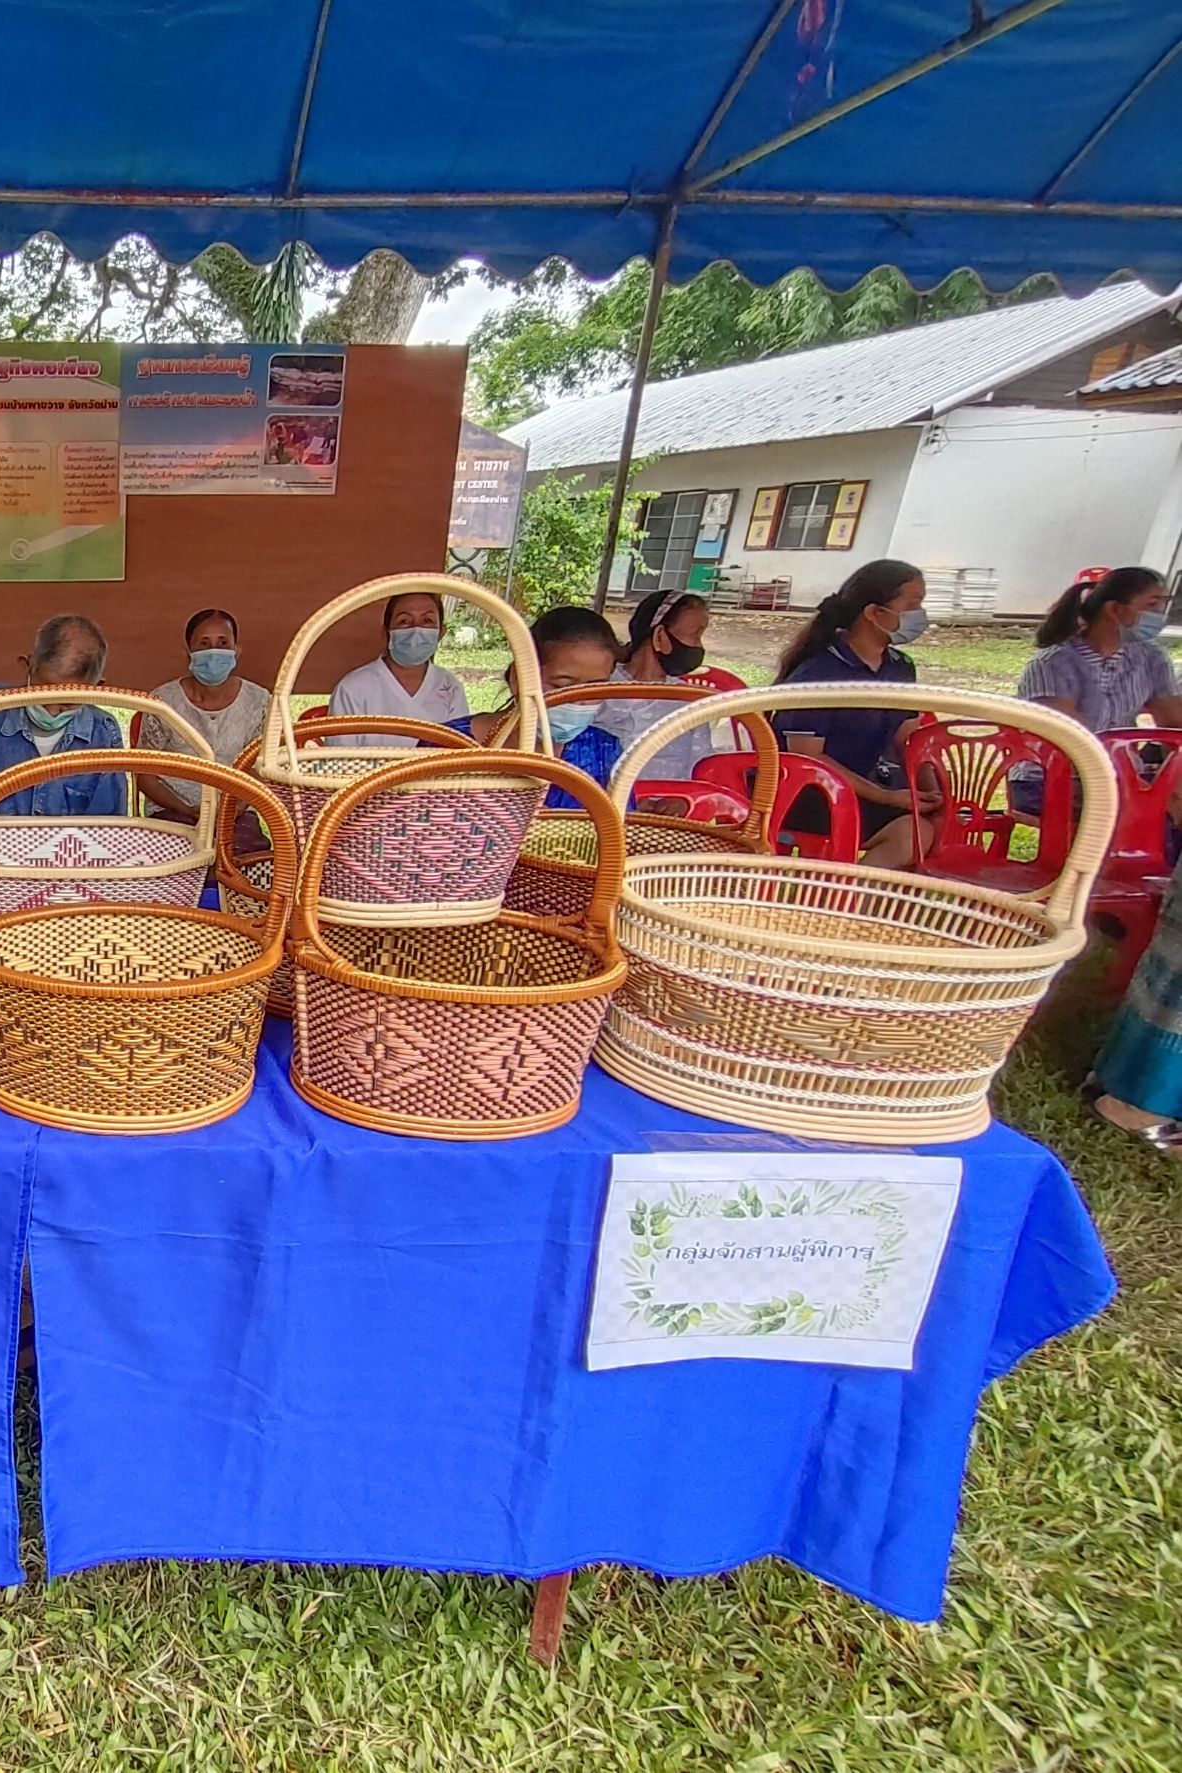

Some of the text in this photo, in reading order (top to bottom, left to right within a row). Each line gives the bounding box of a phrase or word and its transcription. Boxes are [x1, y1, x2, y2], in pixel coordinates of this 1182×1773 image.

[467, 480, 498, 489] CENTER
[666, 1238, 875, 1265] กลุ่มจักสานผู้พิการ
